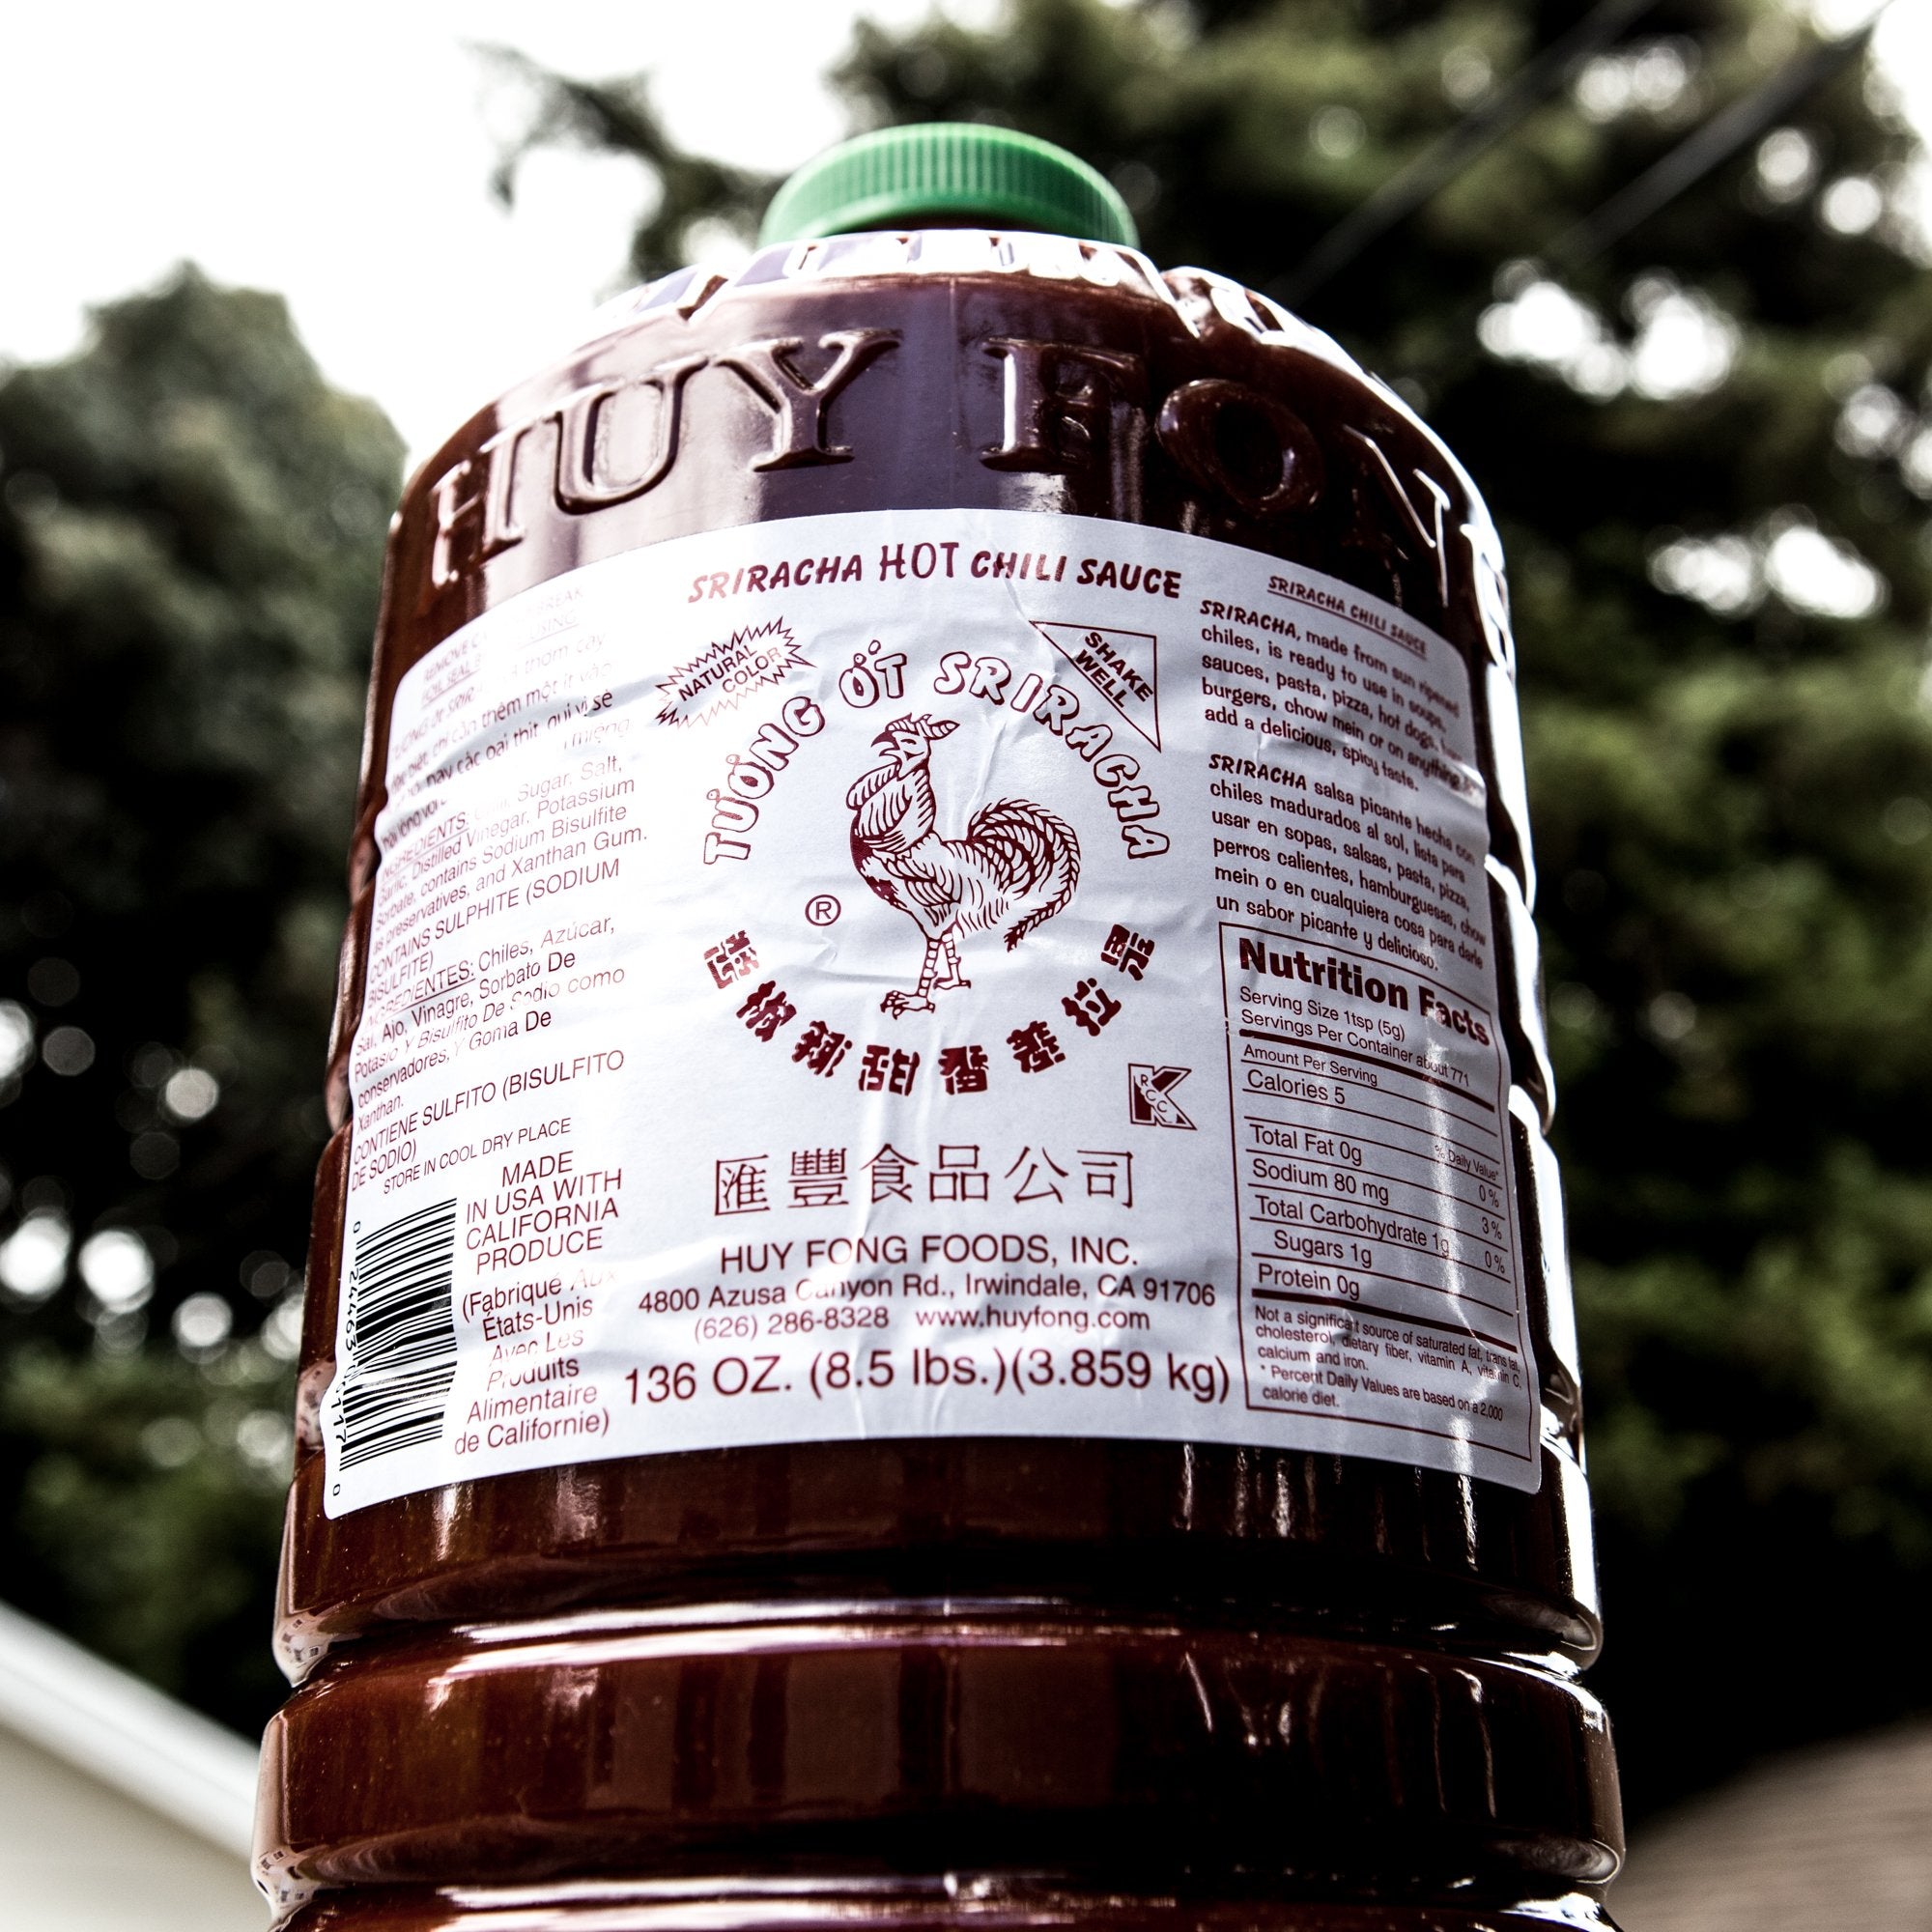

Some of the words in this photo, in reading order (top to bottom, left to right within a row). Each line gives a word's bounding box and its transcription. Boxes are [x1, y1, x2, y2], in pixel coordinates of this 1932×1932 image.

[432, 327, 903, 588] HUY
[688, 554, 862, 603] SRIRACHA
[879, 542, 959, 582] HOT
[971, 551, 1066, 582] CHILI
[1077, 558, 1181, 599] SAUCE
[1268, 576, 1346, 612] SRIRACHA
[1200, 599, 1301, 642] SRIRACHA,
[1306, 630, 1349, 656] made
[1354, 644, 1387, 674] from
[1202, 627, 1260, 654] chiles,
[1290, 650, 1335, 681] ready
[1363, 677, 1387, 698] use
[678, 644, 757, 701] NATURAL
[723, 647, 781, 694] COLOR
[1074, 650, 1127, 708] WELL
[1085, 632, 1153, 702] SHAKE
[1202, 654, 1269, 683] sauces,
[1277, 671, 1326, 700] pasta,
[1333, 690, 1373, 720] pizza,
[1202, 677, 1276, 711] burgers,
[1285, 696, 1327, 723] chow
[1332, 714, 1364, 741] mein
[581, 755, 622, 780] Salt,
[933, 651, 1170, 860] SRIRACHA
[1205, 706, 1237, 726] add
[1261, 718, 1336, 756] delicious,
[1343, 746, 1379, 774] spicy
[1208, 753, 1307, 790] SRIRACHA
[1314, 781, 1353, 806] salsa
[1360, 797, 1412, 829] picante
[1210, 780, 1263, 805] chiles
[1270, 794, 1361, 834] madurados
[412, 838, 461, 880] Distilled
[468, 810, 529, 847] Vinegar,
[537, 779, 635, 819] Potassium
[421, 856, 476, 897] contains
[483, 828, 545, 864] Sodium
[553, 806, 627, 838] Bisulfite
[1211, 810, 1250, 829] usar
[1258, 820, 1278, 837] en
[1285, 826, 1336, 854] sopas,
[1344, 842, 1392, 873] salsas,
[1397, 861, 1435, 894] pasta,
[476, 866, 505, 892] and
[511, 840, 585, 877] Xanthan
[593, 826, 647, 851] Gum.
[1213, 837, 1270, 862] perros
[1277, 850, 1352, 887] calientes,
[1359, 870, 1457, 932] hamburguesas,
[435, 887, 520, 940] SULPHITE
[526, 858, 620, 905] (SODIUM
[1214, 866, 1259, 887] mein
[1284, 880, 1304, 898] en
[1311, 886, 1389, 924] cualquiera
[1394, 914, 1425, 938] cosa
[479, 939, 533, 973] Chiles,
[541, 917, 615, 949] Azúcar,
[1216, 895, 1239, 912] un
[1246, 898, 1294, 924] sabor
[1300, 911, 1358, 941] picante
[1378, 931, 1439, 972] delicioso.
[412, 991, 474, 1030] Vinagre,
[479, 961, 540, 999] Sorbato
[549, 951, 576, 973] De
[417, 1013, 478, 1049] Bisulfito
[483, 1004, 505, 1023] De
[567, 968, 626, 994] como
[1238, 937, 1408, 1011] Nutrition
[1417, 985, 1491, 1046] Facts
[1240, 986, 1303, 1014] Serving
[1308, 1000, 1339, 1021] Size
[1344, 1010, 1374, 1034] 1tsp
[1378, 1018, 1405, 1042] (5g)
[469, 1020, 518, 1051] Goma
[525, 1010, 552, 1033] De
[1242, 1009, 1313, 1037] Servings
[1319, 1024, 1343, 1043] Per
[1348, 1032, 1412, 1064] Container
[1416, 1052, 1448, 1077] about
[1244, 1043, 1298, 1065] Amount
[1303, 1054, 1327, 1072] Per
[1330, 1060, 1378, 1087] Serving
[1247, 1068, 1329, 1101] Calories
[1335, 1087, 1346, 1105] 5
[353, 1111, 418, 1166] CONTIENE
[422, 1082, 497, 1126] SULFITO
[502, 1049, 625, 1101] (BISULFITO
[383, 1165, 420, 1195] STORE
[439, 1146, 477, 1170] COOL
[482, 1132, 513, 1155] DRY
[518, 1118, 571, 1144] PLACE
[501, 1150, 574, 1187] MADE
[1250, 1123, 1297, 1151] Total
[1305, 1132, 1334, 1157] Fat
[1340, 1141, 1362, 1167] 0g
[467, 1199, 487, 1225] IN
[495, 1185, 545, 1215] USA
[553, 1168, 622, 1202] WITH
[714, 1144, 1134, 1216] 匯豐食品公司
[1253, 1159, 1328, 1188] Sodium
[1334, 1174, 1356, 1195] 80
[1363, 1183, 1389, 1207] mg
[466, 1197, 619, 1250] CALIFORNIA
[1255, 1195, 1302, 1220] Total
[1310, 1204, 1427, 1246] Carbohydrate
[1274, 1230, 1344, 1259] Sugars
[476, 1227, 603, 1275] PRODUCE
[721, 1241, 794, 1274] HUY
[806, 1236, 908, 1268] FONG
[922, 1234, 1058, 1268] FOODS,
[1072, 1236, 1138, 1266] INC.
[463, 1272, 561, 1323] (Fabriqué
[639, 1288, 699, 1313] 4800
[708, 1285, 785, 1309] Azusa
[903, 1273, 954, 1299] Rd.,
[966, 1273, 1088, 1300] Irwindale,
[1097, 1273, 1135, 1298] CA
[1143, 1277, 1215, 1307] 91706
[1259, 1264, 1331, 1292] Protein
[1337, 1275, 1360, 1301] 0g
[482, 1298, 593, 1342] États-Unis
[695, 1315, 757, 1344] (626)
[767, 1307, 889, 1335] 286-8328
[916, 1305, 1151, 1334] www.huyfong.com
[1256, 1305, 1280, 1321] Not
[1363, 1324, 1400, 1342] source
[1416, 1335, 1464, 1356] saturated
[1256, 1324, 1335, 1347] cholesterol,
[1342, 1335, 1378, 1354] dietary
[1418, 1351, 1455, 1372] vitamin
[625, 1362, 696, 1406] 136
[712, 1355, 791, 1397] OZ.
[810, 1349, 895, 1401] (8.5
[1167, 1352, 1230, 1405] kg)
[1258, 1344, 1310, 1363] calcium
[1316, 1350, 1340, 1367] and
[468, 1383, 597, 1425] Alimentaire
[1327, 1371, 1358, 1392] Daily
[1361, 1377, 1399, 1396] Values
[1423, 1389, 1455, 1408] based
[455, 1432, 479, 1456] de
[487, 1407, 610, 1449] Californie)
